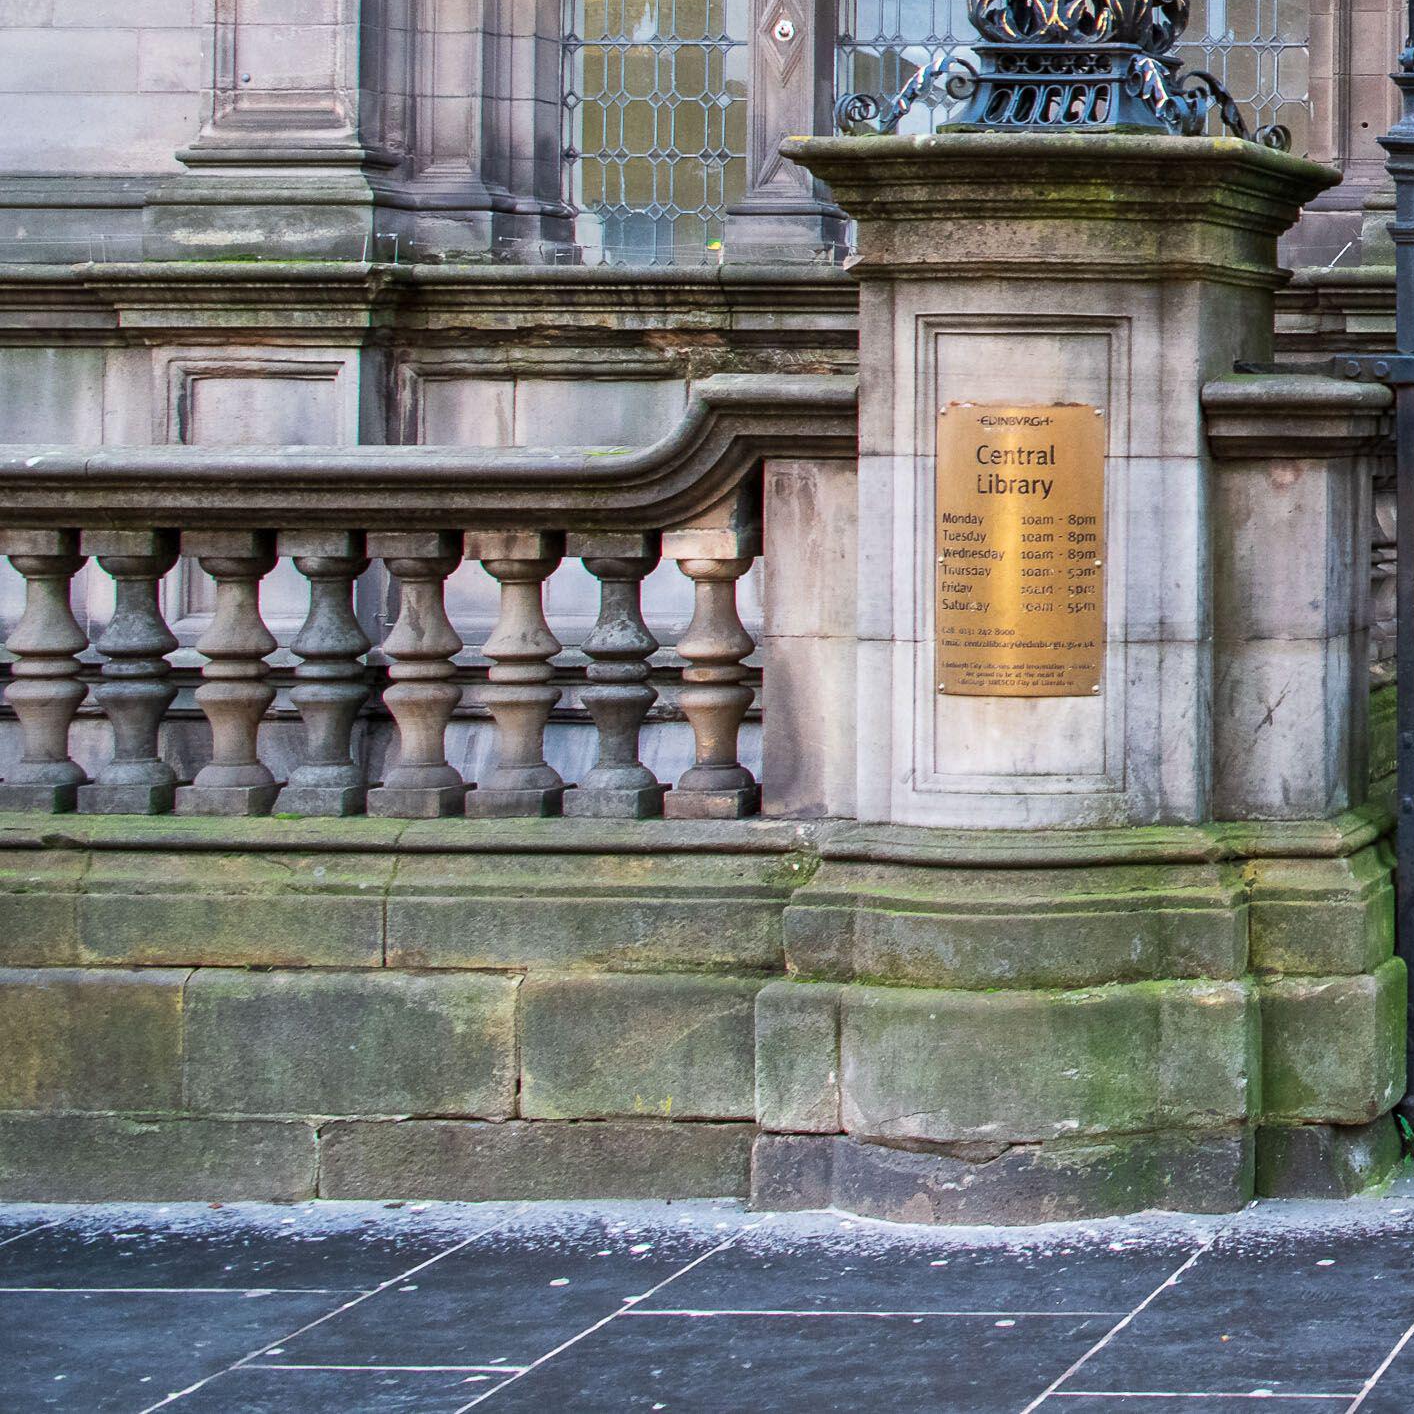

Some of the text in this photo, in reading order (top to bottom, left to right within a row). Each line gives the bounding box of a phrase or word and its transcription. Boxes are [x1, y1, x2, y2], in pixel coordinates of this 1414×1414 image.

[976, 444, 1056, 466] Central
[977, 473, 1054, 500] Library
[942, 512, 985, 526] Monday
[1021, 516, 1054, 525] 10am
[1067, 514, 1096, 526] 8pm
[943, 529, 987, 544] Tuesday
[1021, 533, 1054, 543] 10am
[1067, 531, 1097, 544] 8pm
[943, 548, 1005, 561] Wednesday
[1021, 550, 1054, 560] 10am
[1067, 549, 1096, 562] 8pm
[943, 565, 992, 578] Thursday
[1021, 567, 1054, 577] 10am
[941, 581, 973, 595] Friday
[942, 599, 991, 612] Saturday
